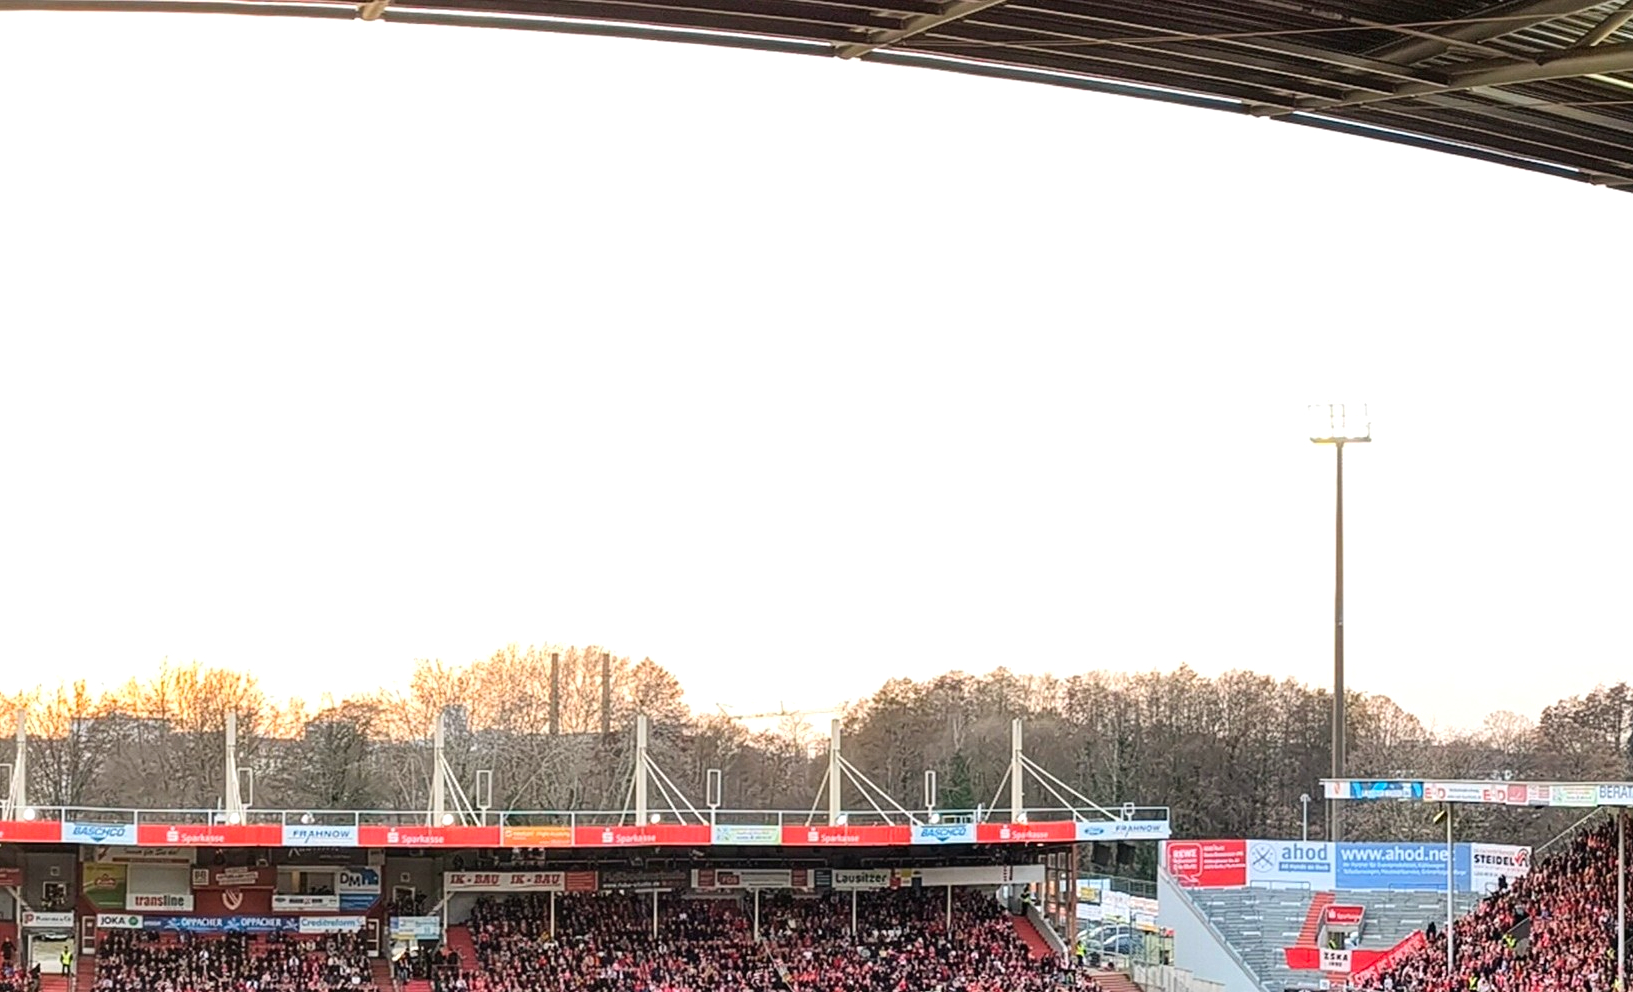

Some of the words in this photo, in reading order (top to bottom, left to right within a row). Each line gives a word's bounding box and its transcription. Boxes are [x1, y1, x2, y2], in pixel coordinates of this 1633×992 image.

[72, 827, 126, 837] BASCHCO
[293, 829, 350, 842] FRAHNOW
[920, 827, 967, 838] BASCHCO
[1011, 830, 1049, 840] Sparkasse
[181, 833, 225, 843] Sparkasse
[401, 834, 445, 845] Sparkasse
[616, 833, 657, 843] Sparkasse
[820, 834, 860, 844] Sparkasse
[1281, 843, 1329, 861] ahod
[1473, 853, 1515, 867] STEIDEL
[450, 874, 464, 884] IK
[474, 874, 500, 885] BAU
[510, 874, 524, 884] IK
[534, 874, 561, 885] BAU
[835, 872, 888, 884] Lausitzer
[134, 895, 185, 907] transline
[100, 916, 126, 925] JOKA
[181, 917, 223, 927] OPPACHER
[240, 917, 281, 927] OPPACHER
[301, 918, 357, 928] Creditreform
